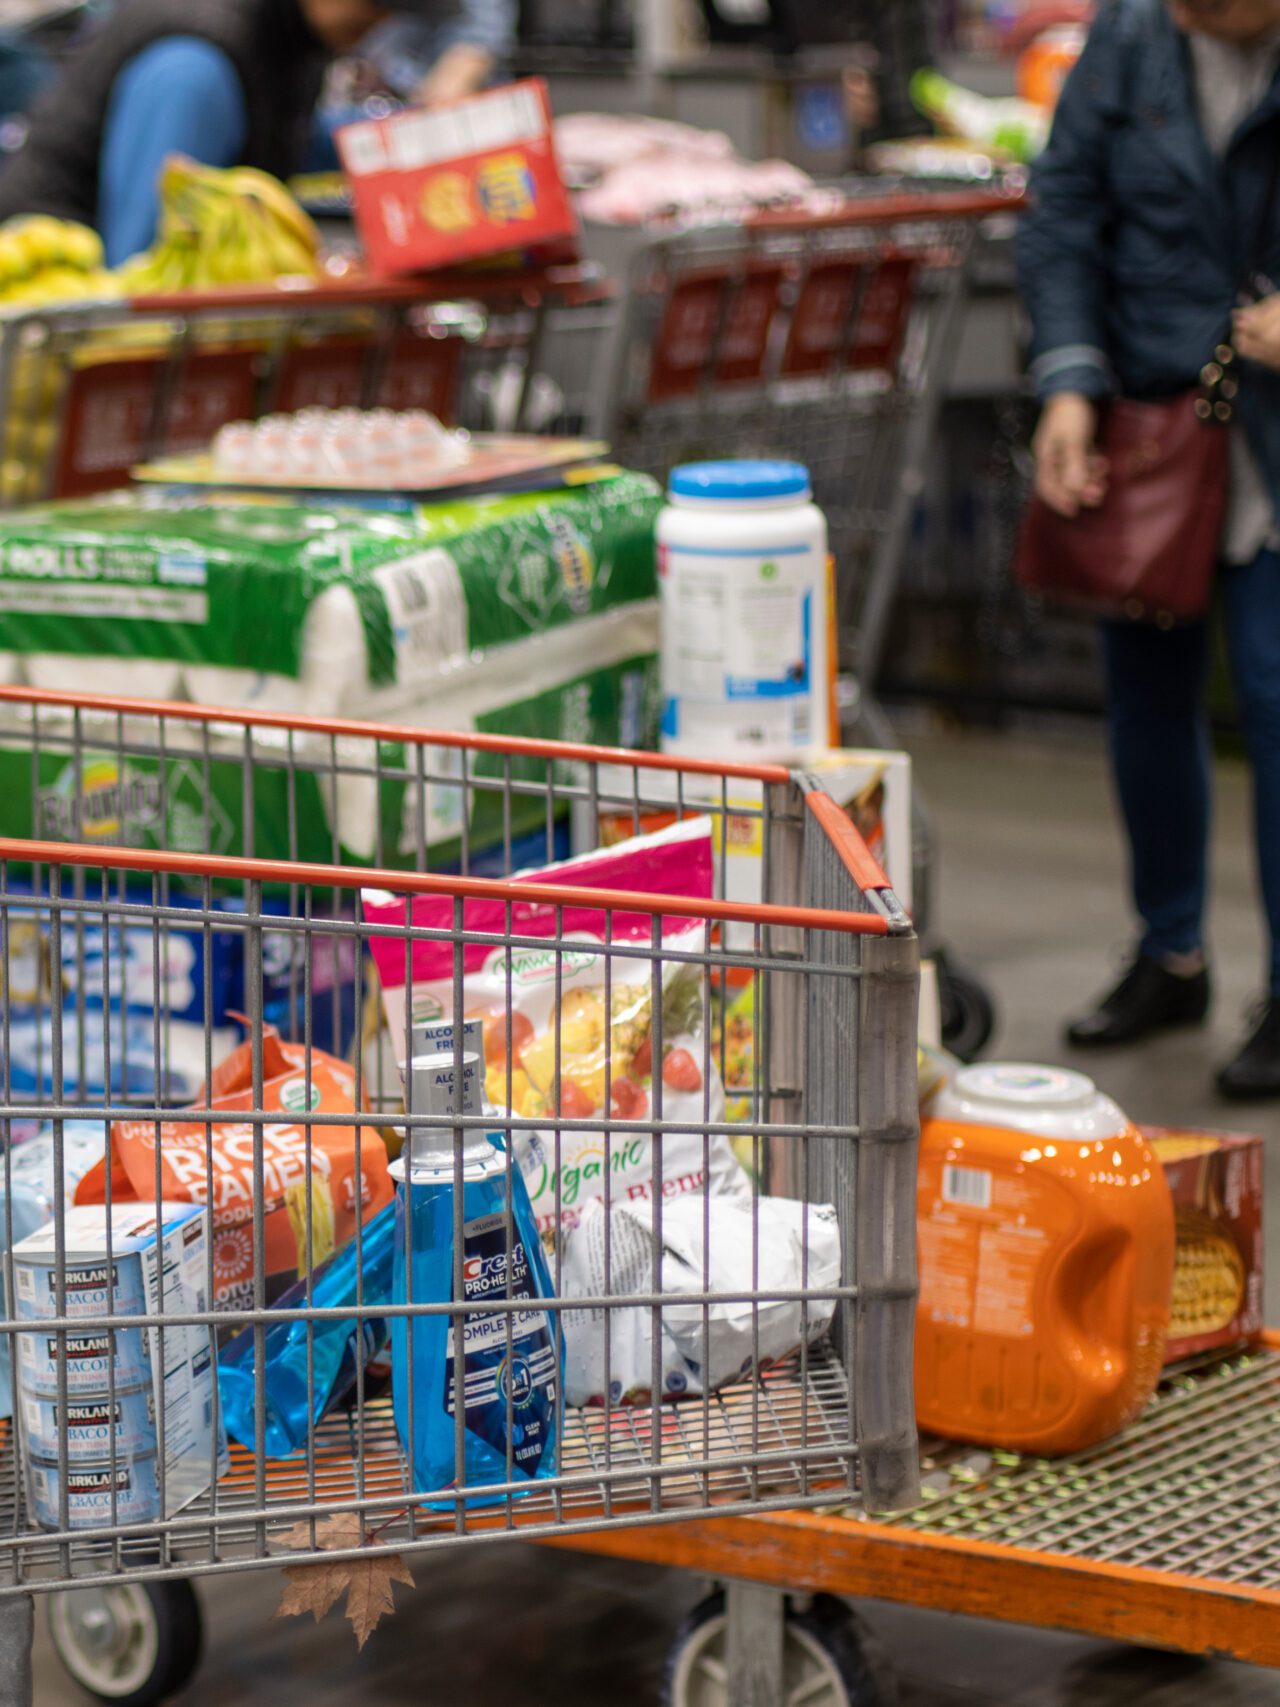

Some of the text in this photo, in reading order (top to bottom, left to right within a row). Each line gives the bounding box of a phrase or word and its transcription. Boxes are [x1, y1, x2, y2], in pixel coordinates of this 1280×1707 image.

[425, 1025, 474, 1040] ALCOOL
[435, 1069, 475, 1085] ALCOL
[448, 1082, 469, 1095] FE
[163, 1121, 307, 1184] RICE
[186, 1147, 333, 1210] RAMEN
[211, 1199, 277, 1227] OODLS
[51, 1268, 116, 1285] RKLAN
[48, 1288, 122, 1306] ABACOE
[217, 1278, 255, 1302] OTUS
[469, 1291, 531, 1321] ADCED
[452, 1315, 517, 1341] OMPLEE
[50, 1337, 111, 1352] KRKLAN
[47, 1358, 122, 1373] ABACOE
[56, 1404, 120, 1420] RKLAND
[52, 1425, 126, 1441] ABACORE
[67, 1471, 128, 1487] KIRKLAD
[69, 1490, 132, 1508] LBACORE
